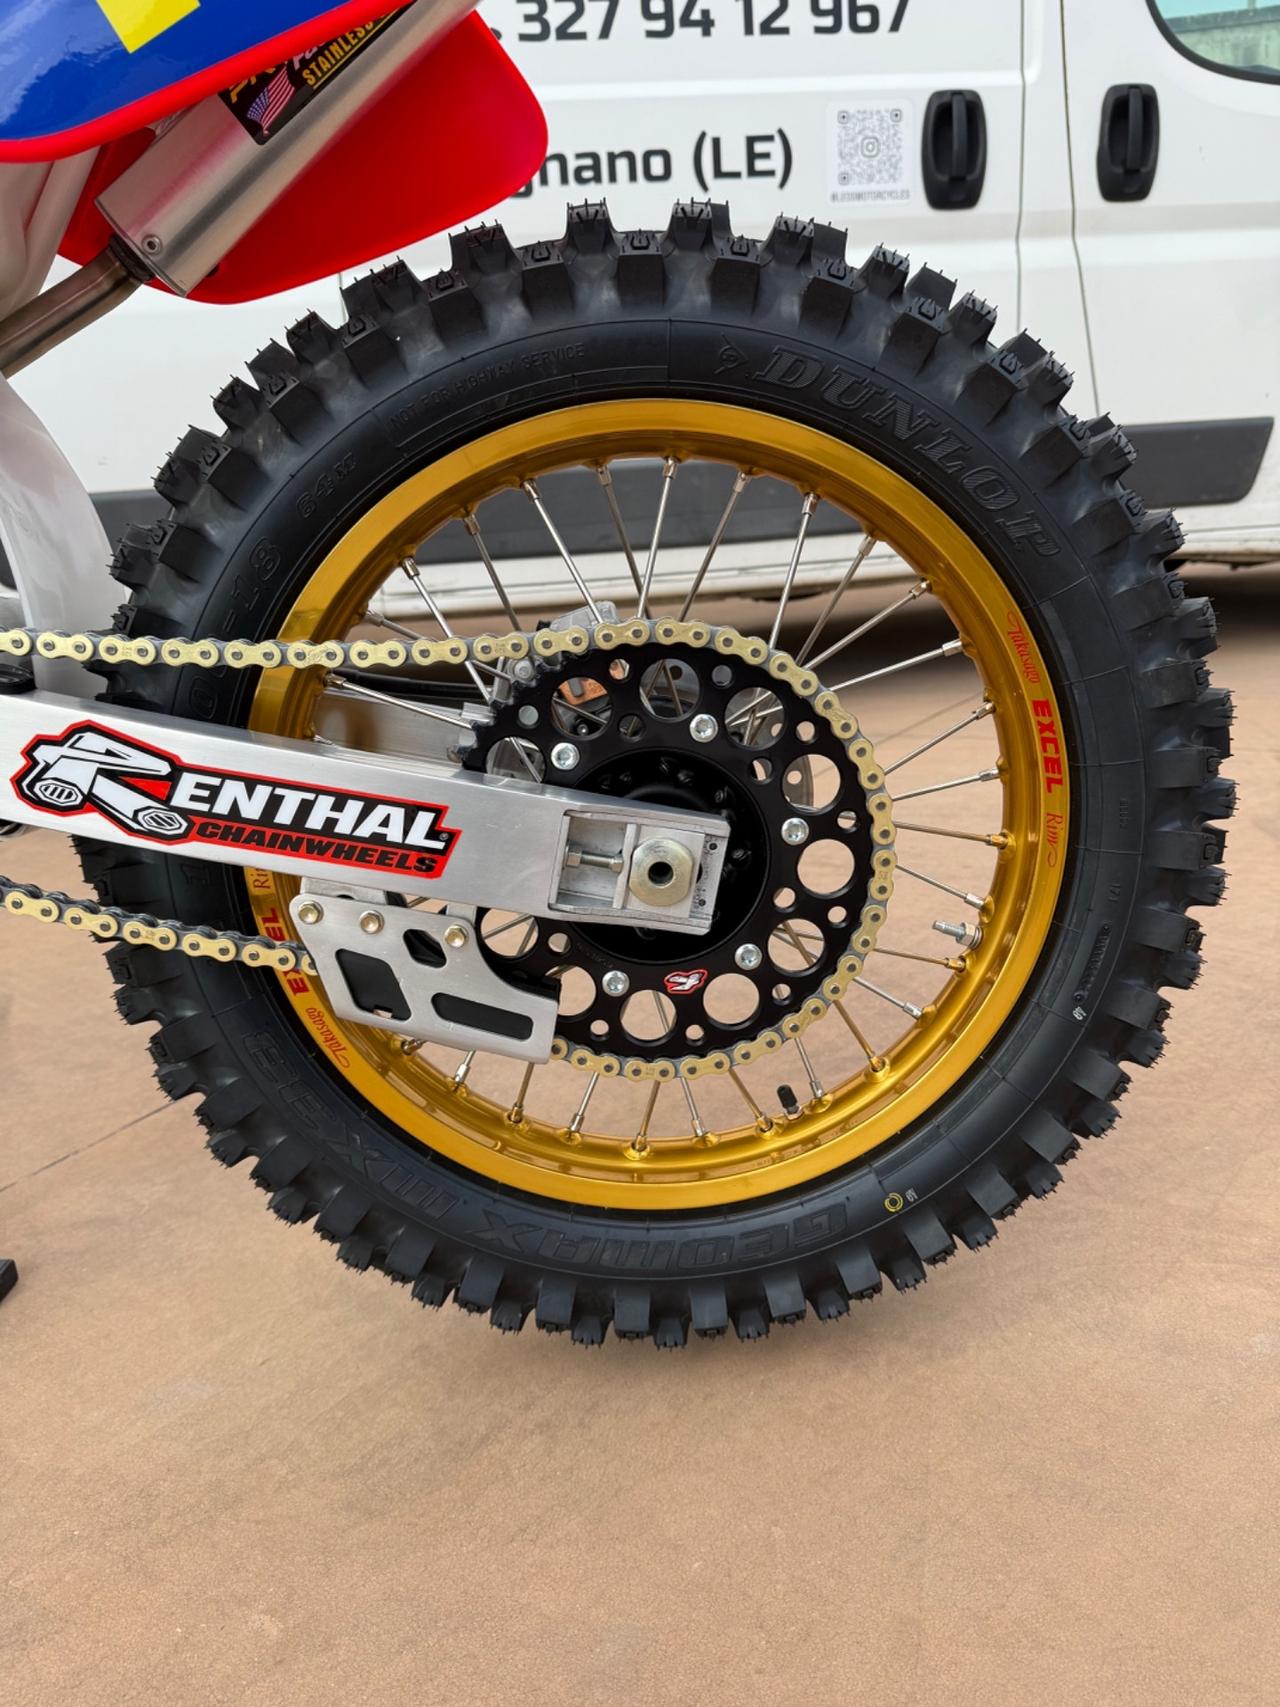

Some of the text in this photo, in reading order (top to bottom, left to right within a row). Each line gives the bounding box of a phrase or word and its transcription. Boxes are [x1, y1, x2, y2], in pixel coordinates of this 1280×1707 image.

[518, 0, 617, 41] 327
[641, 0, 716, 38] 94
[734, 0, 790, 36] 12
[811, 0, 911, 34] 967
[693, 128, 792, 192] (LE)
[389, 342, 586, 427] NOT FOR HIGHWAY SERVICE
[752, 344, 1061, 558] DUNLOP
[1032, 699, 1064, 794] EXCEL
[23, 730, 449, 873] RENTHAL CHAINWHEELS
[1046, 811, 1064, 862] Rim
[305, 1007, 350, 1068] Takasago
[466, 1202, 848, 1268] GEOMAX
